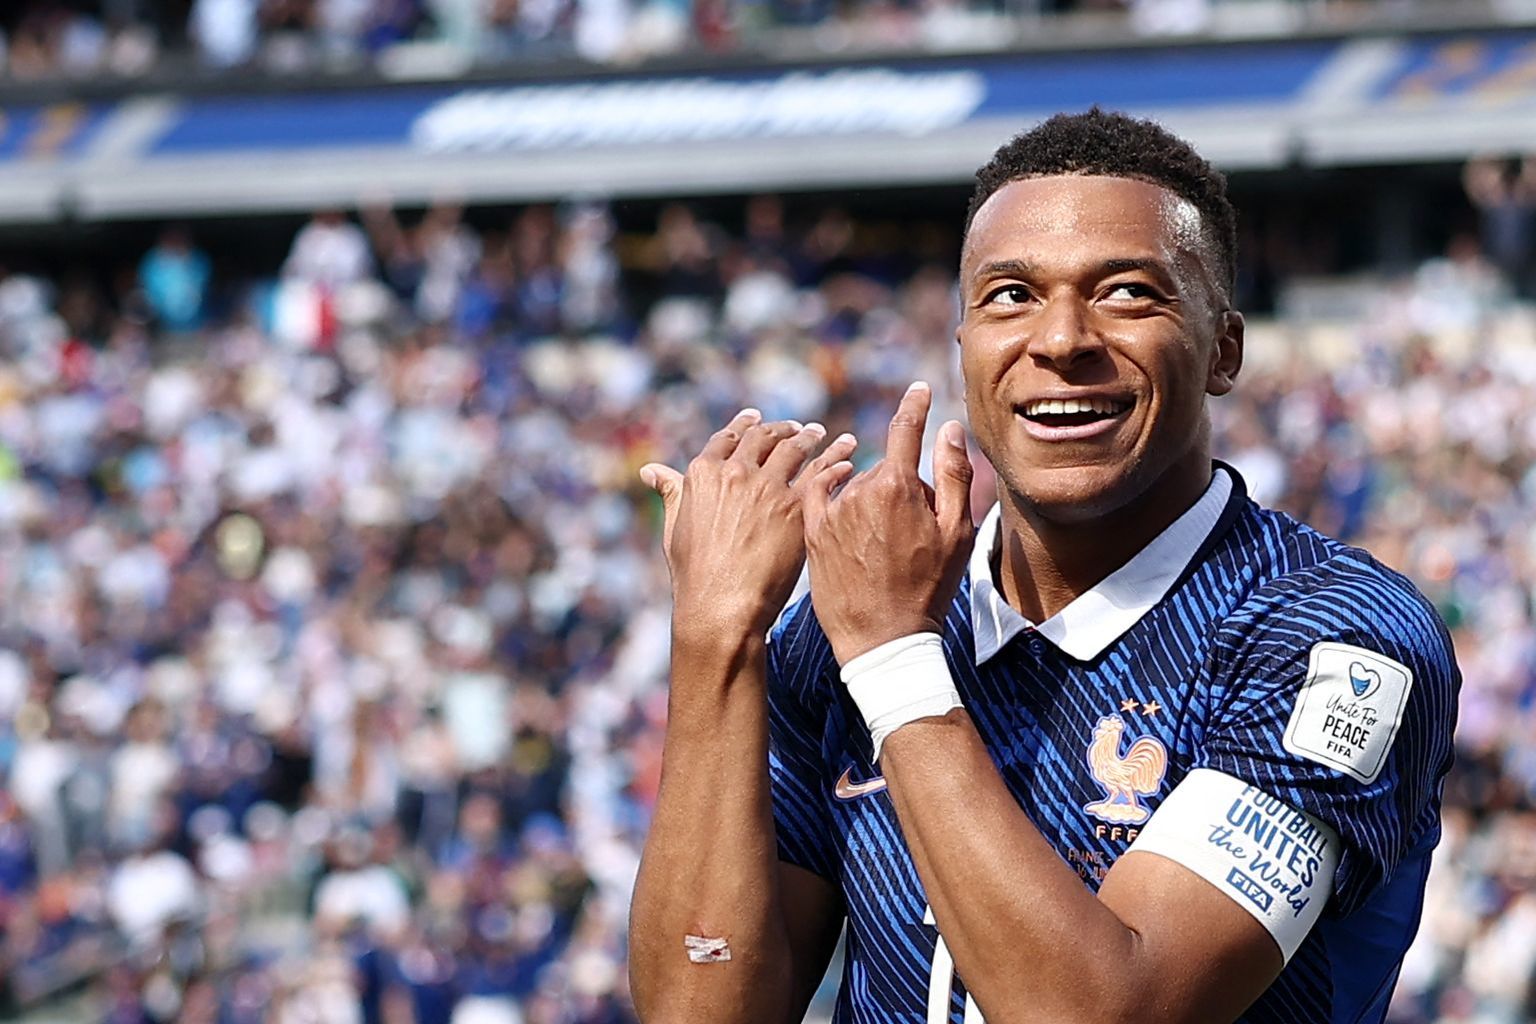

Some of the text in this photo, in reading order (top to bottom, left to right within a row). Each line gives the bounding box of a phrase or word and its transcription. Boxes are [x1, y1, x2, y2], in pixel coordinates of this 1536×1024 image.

[1326, 693, 1378, 726] Unite For
[1322, 714, 1370, 750] PEACE
[1326, 740, 1353, 759] FIFA
[1226, 798, 1319, 888] UNITES
[1208, 824, 1310, 918] the World
[1228, 867, 1272, 912] FIFA
